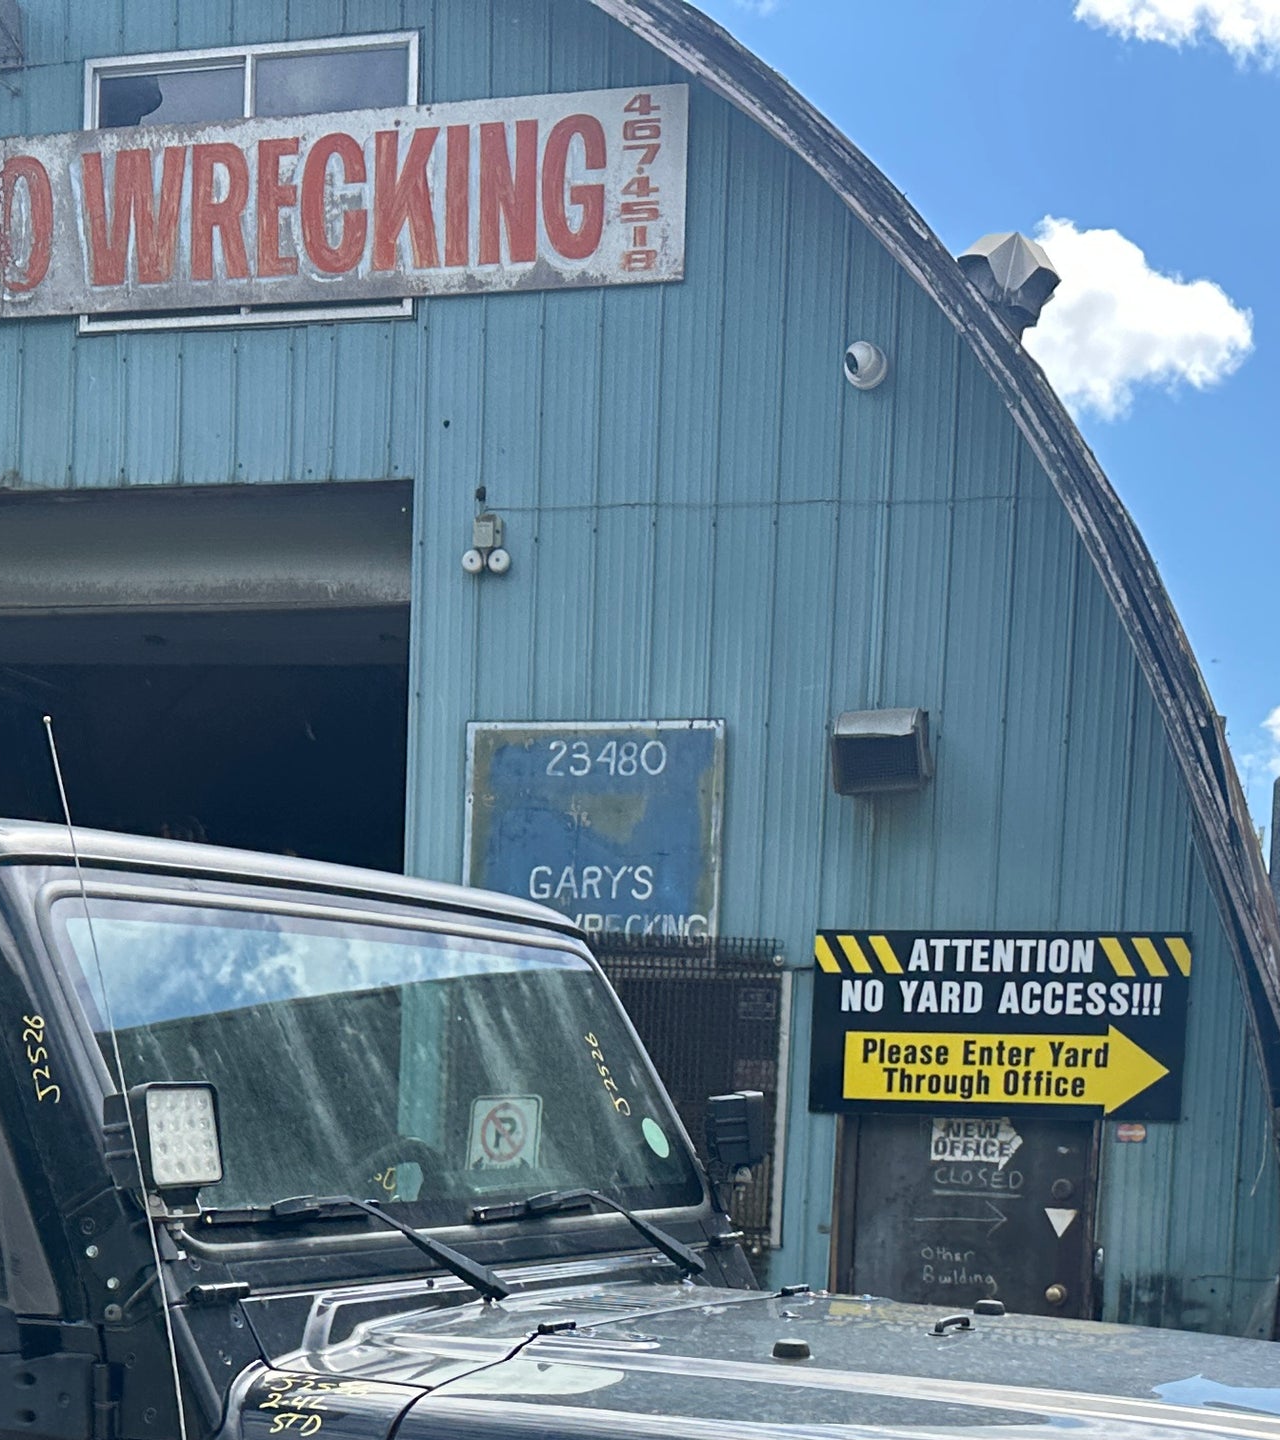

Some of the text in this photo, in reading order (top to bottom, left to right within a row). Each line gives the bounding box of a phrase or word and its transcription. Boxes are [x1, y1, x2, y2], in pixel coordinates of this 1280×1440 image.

[80, 112, 608, 287] WRECKING
[546, 740, 667, 777] 23480
[528, 864, 654, 900] GARY'S
[572, 912, 709, 946] RECKING
[907, 938, 1095, 974] ATTENTION
[840, 979, 1163, 1016] NO YARD ACCESS!!!
[23, 1014, 61, 1104] J2526
[862, 1038, 1109, 1069] Please Enter Yard
[883, 1068, 1085, 1100] Through Office
[945, 1120, 999, 1139] NEW
[934, 1136, 1011, 1158] OFFICE
[934, 1166, 1024, 1189] CLOSED
[921, 1246, 975, 1262] Other
[269, 1412, 322, 1437] STD
